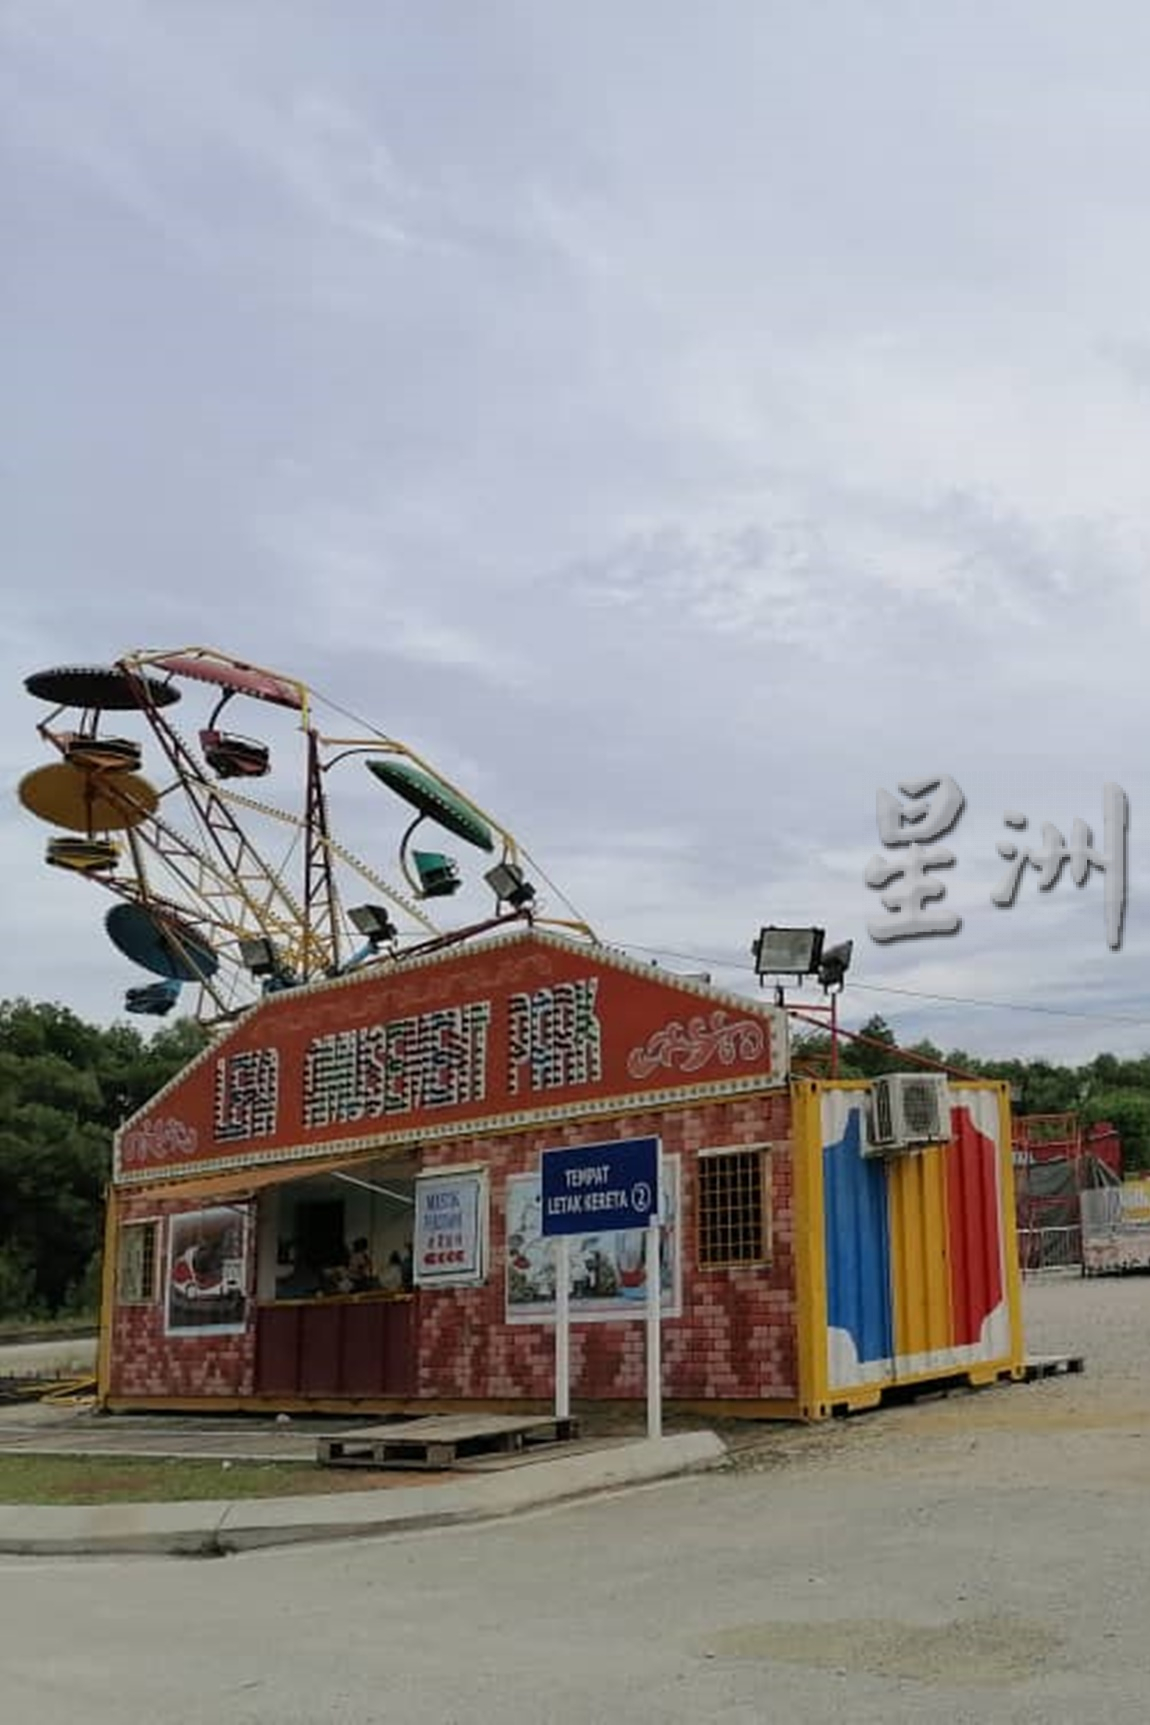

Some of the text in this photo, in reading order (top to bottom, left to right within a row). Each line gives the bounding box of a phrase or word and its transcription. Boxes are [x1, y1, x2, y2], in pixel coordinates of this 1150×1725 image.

[507, 977, 602, 1095] PARK
[565, 1164, 610, 1188] TEMPAT
[548, 1194, 582, 1215] LETAK
[583, 1189, 629, 1212] KERETA
